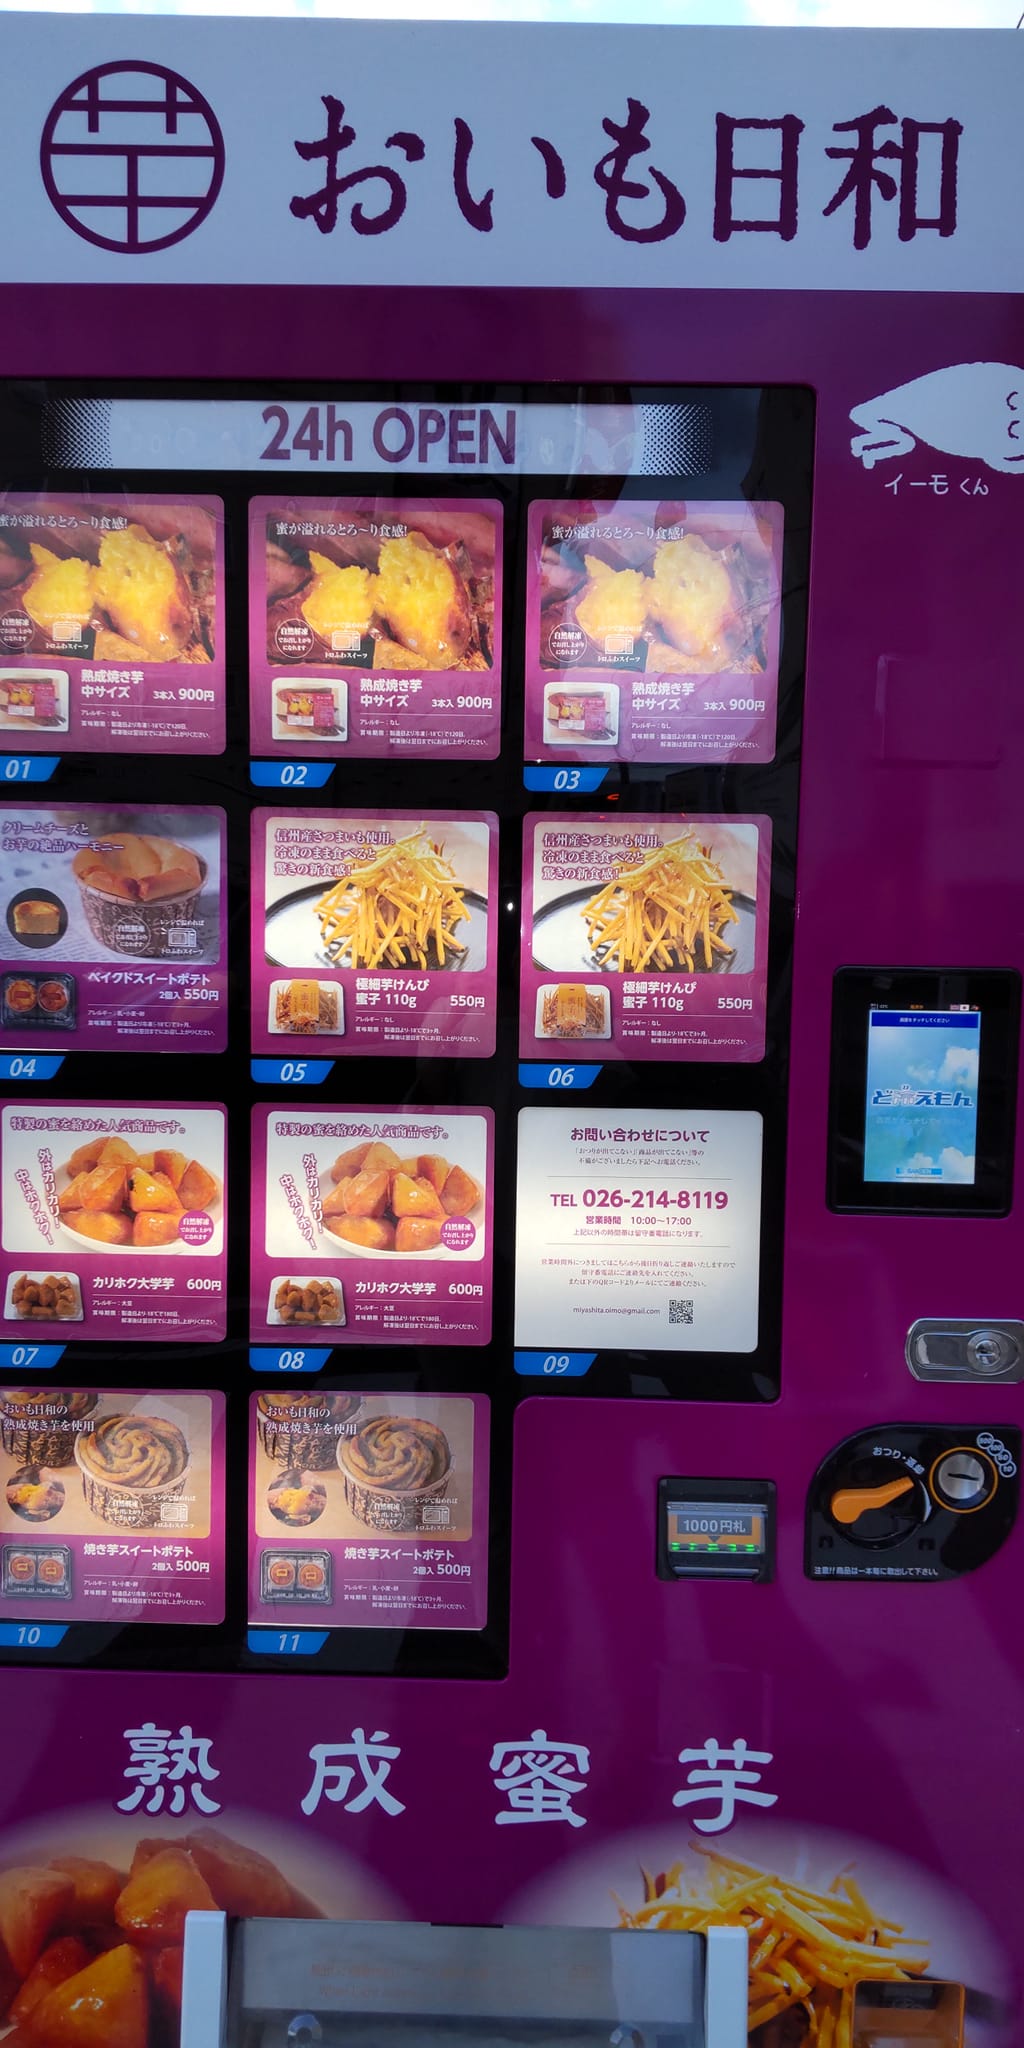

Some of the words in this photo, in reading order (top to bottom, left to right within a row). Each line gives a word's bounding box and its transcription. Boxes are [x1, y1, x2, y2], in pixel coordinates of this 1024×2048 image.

[289, 95, 964, 250] おいも日和
[259, 404, 353, 462] 24h
[371, 406, 517, 465] OPEN
[81, 669, 144, 684] 熟成焼き芋
[360, 678, 422, 693] 熟成焼き芋
[632, 682, 695, 696] 熟成焼き芋
[81, 686, 130, 699] 中サイズ
[153, 690, 176, 701] 3本入
[178, 688, 215, 702] 900円
[360, 695, 409, 708] 中サイズ
[431, 698, 454, 709] 3本入
[457, 696, 492, 710] 900円
[632, 697, 680, 711] 中サイズ
[704, 701, 726, 711] 3本入
[730, 699, 765, 712] 900円
[5, 759, 32, 779] 01
[280, 766, 308, 785] 02
[553, 770, 581, 790] 03
[3, 821, 89, 836] クリームチーズと
[275, 828, 397, 846] 信州産さつまいも使用。
[543, 832, 664, 848] 信州産さつまいも使用。
[3, 838, 124, 852] お芋の絶品ハーモニー
[275, 846, 377, 861] 冷凍のまま食べると
[543, 850, 644, 864] 冷凍のまま食べると
[356, 978, 430, 991] 極細芋けんぴ
[622, 981, 697, 995] 極細芋けんぴ
[160, 991, 181, 1000] 2個入
[184, 989, 219, 1001] 550円
[385, 993, 417, 1008] 110g
[450, 995, 485, 1008] 550円
[622, 997, 647, 1009] 蜜子
[652, 997, 684, 1011] 110g
[717, 998, 752, 1010] 550円
[9, 1058, 36, 1077] 04
[280, 1063, 307, 1082] 05
[548, 1067, 574, 1086] 06
[10, 1117, 185, 1134] 特製の蜜を絡めた人気商品です。
[275, 1122, 449, 1139] 特製の蜜を絡めた人気商品です。
[570, 1127, 710, 1143] お問い合わせについて
[550, 1194, 577, 1207] TEL
[582, 1189, 729, 1210] 026-214-8119
[586, 1215, 622, 1225] 営業時間
[92, 1277, 175, 1290] カリホク大学芋
[187, 1278, 222, 1291] 600円
[355, 1281, 436, 1295] カリホク大学芋
[448, 1283, 483, 1296] 600円
[573, 1306, 661, 1315] miyashita.oimo@gmail.com
[11, 1347, 39, 1366] 07
[278, 1351, 304, 1370] 08
[543, 1356, 569, 1374] 09
[3, 1403, 68, 1415] おいも日和の
[266, 1407, 331, 1418] おいも日和の
[3, 1420, 95, 1432] 熟成焼き芋を使用
[266, 1422, 357, 1435] 熟成焼き芋を使用
[683, 1519, 746, 1533] 1000円札
[84, 1543, 193, 1557] 焼き芋スイートポテト
[344, 1547, 454, 1561] 焼き芋スイートポテト
[152, 1562, 174, 1572] 2個入
[176, 1560, 210, 1573] 500円
[413, 1566, 434, 1576] 2個入
[437, 1564, 471, 1576] 500円
[17, 1627, 41, 1644] 10
[279, 1634, 300, 1652] 11
[117, 1722, 778, 1834] 熟成蜜芋
